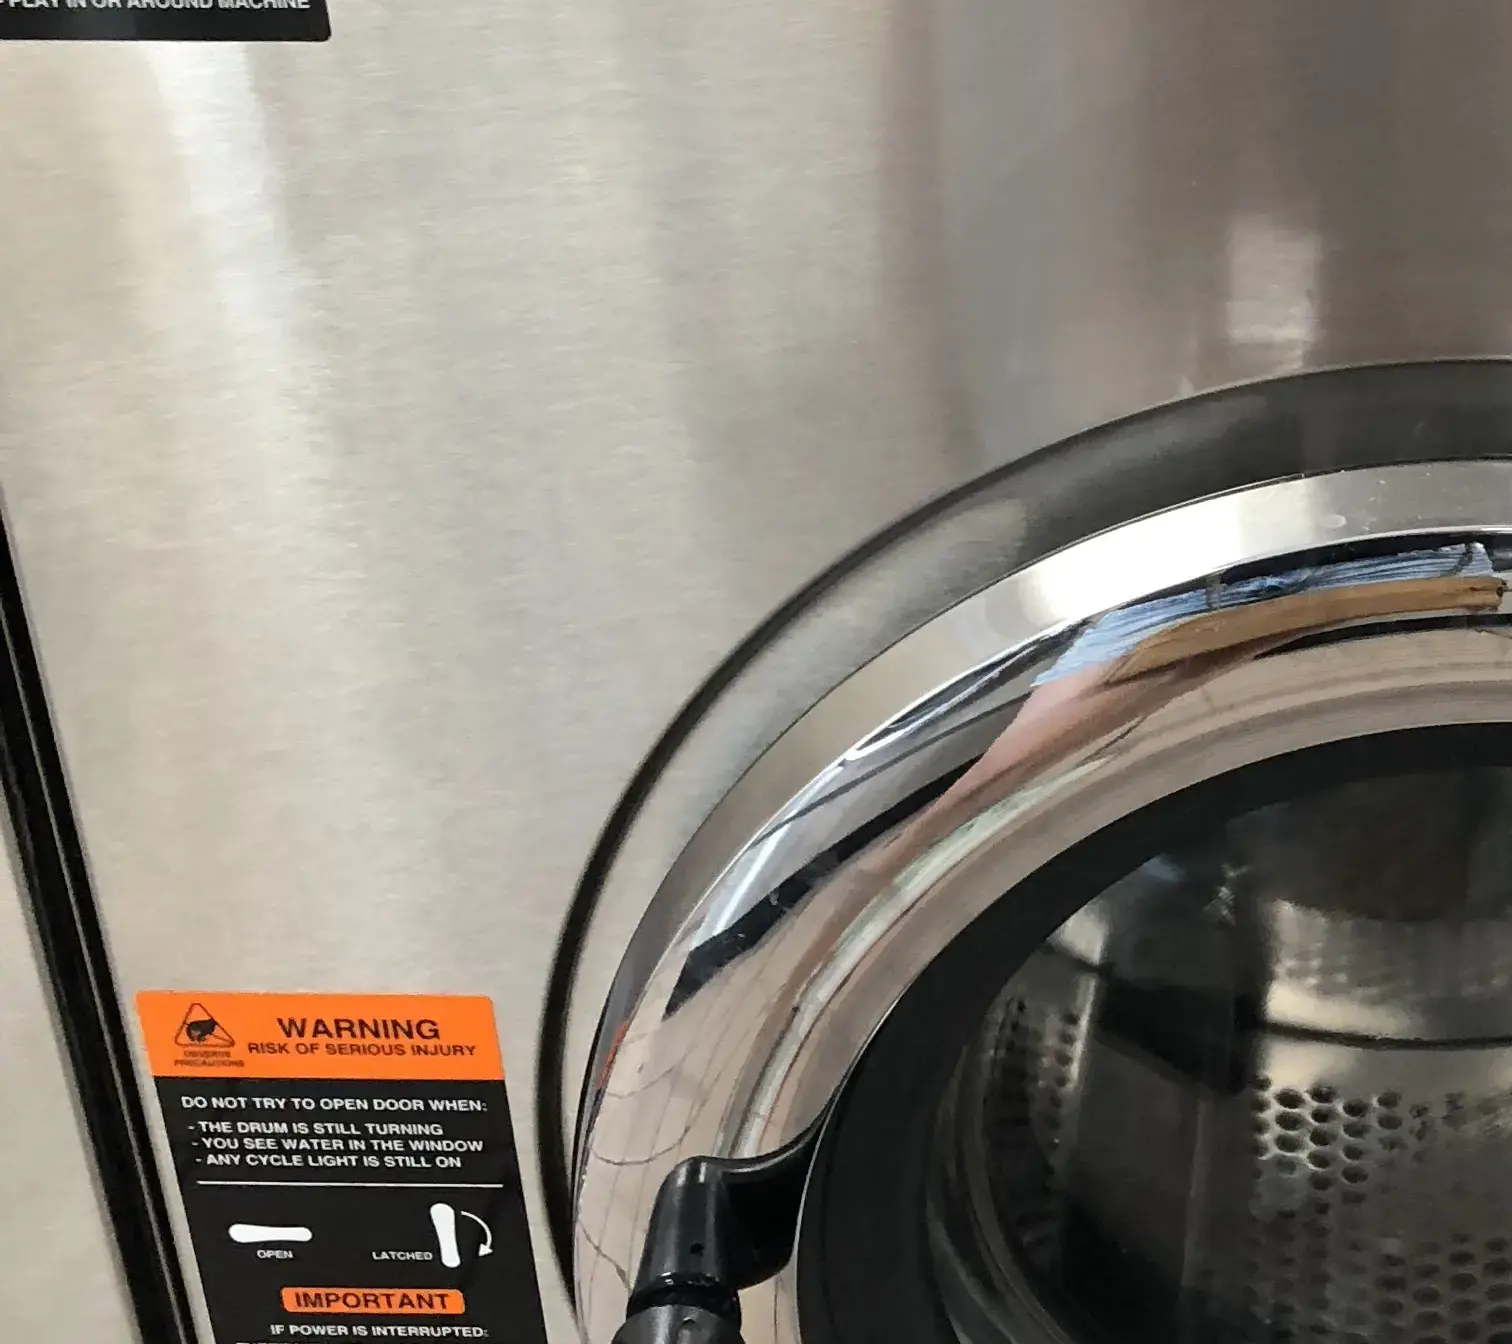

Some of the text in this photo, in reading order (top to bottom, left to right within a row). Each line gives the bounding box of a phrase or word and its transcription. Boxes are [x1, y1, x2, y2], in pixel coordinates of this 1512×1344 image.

[276, 1017, 441, 1040] WARNING
[247, 1042, 291, 1055] RISK
[295, 1042, 320, 1055] OF
[325, 1043, 406, 1056] SERIOUS
[410, 1044, 476, 1057] INJURY
[180, 1095, 208, 1109] DO
[210, 1096, 248, 1109] NOT
[250, 1097, 287, 1110] TRY
[291, 1097, 316, 1110] TO
[319, 1098, 369, 1111] OPEN
[372, 1098, 424, 1111] DOOR
[197, 1120, 444, 1136] THE DRUM IS STILL TURNING
[201, 1137, 484, 1152] YOU SEE WATER IN THE WINDOW
[206, 1154, 462, 1168] ANY CYCLE LIGHT IS STILL ON
[256, 1249, 294, 1259] OPEN
[371, 1250, 434, 1261] LATCHED
[294, 1291, 450, 1310] IMPORTANT
[270, 1324, 285, 1335] IF
[288, 1324, 349, 1336] POWER
[352, 1325, 369, 1336] IS
